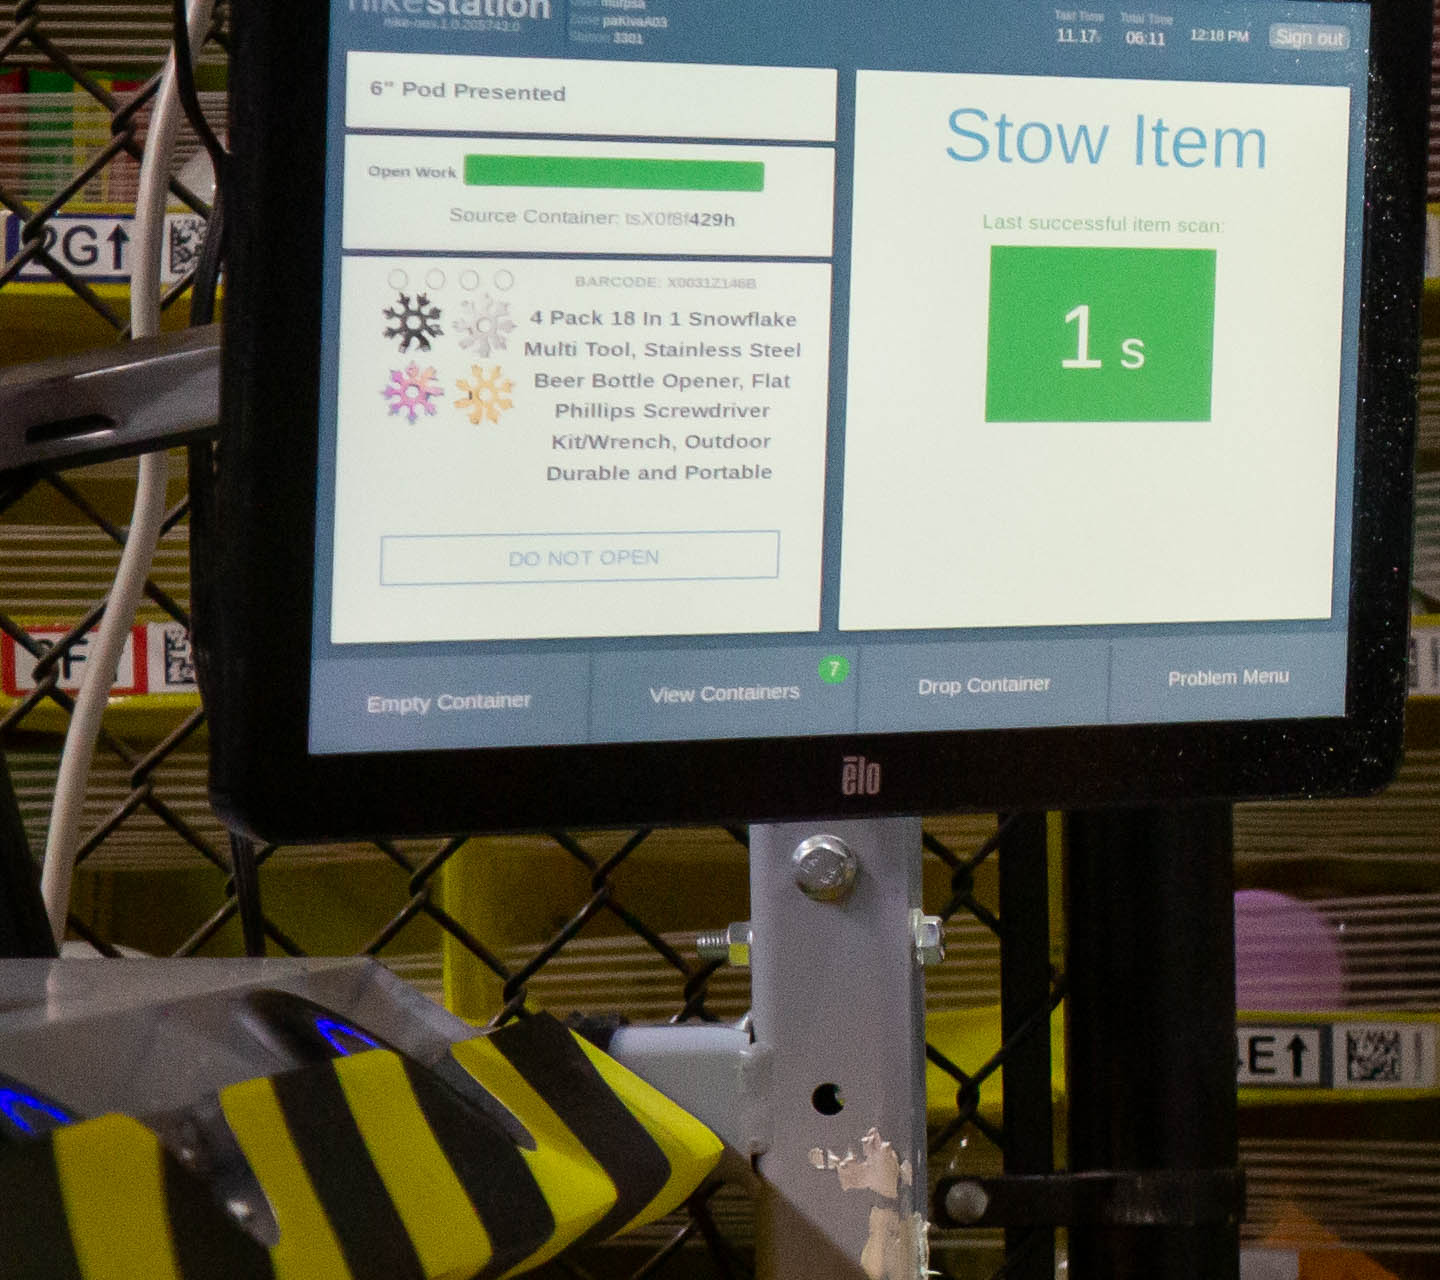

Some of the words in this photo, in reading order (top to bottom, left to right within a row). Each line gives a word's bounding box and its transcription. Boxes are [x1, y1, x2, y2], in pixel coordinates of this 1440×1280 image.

[1125, 30, 1166, 46] 06:11
[1190, 28, 1225, 42] 12:18
[1228, 29, 1250, 43] PM
[1276, 28, 1313, 50] Sign
[1317, 30, 1345, 47] out
[369, 80, 394, 97] 6"
[402, 81, 446, 98] Pod
[454, 82, 567, 103] Presented
[946, 107, 1110, 164] Stow
[1135, 113, 1267, 169] Item
[368, 165, 411, 180] Open
[415, 166, 457, 179] Work
[449, 207, 517, 223] Source
[523, 209, 620, 226] Container:
[983, 213, 1023, 231] Last
[1028, 214, 1128, 233] successful
[1132, 216, 1171, 233] item
[1178, 219, 1225, 234] scan:
[575, 275, 661, 289] BARCODE:
[530, 310, 543, 325] 4
[550, 310, 603, 326] Pack
[612, 311, 636, 326] 18
[643, 311, 662, 326] In
[670, 311, 682, 326] 1
[688, 311, 797, 328] Snowflake
[1061, 304, 1103, 368] 1
[1120, 337, 1146, 370] s
[523, 340, 577, 358] Multi
[585, 341, 637, 360] Tool,
[643, 341, 742, 358] Stainless
[749, 342, 802, 358] Steel
[533, 372, 585, 388] Beer
[591, 372, 655, 388] Bottle
[662, 372, 744, 392] Opener,
[751, 373, 791, 389] Flat
[555, 403, 636, 422] Phillips
[643, 403, 771, 419] Screwdriver
[551, 433, 678, 452] Kit/Wrench,
[684, 433, 772, 450] Outdoor
[546, 464, 630, 481] Durable
[637, 464, 677, 481] and
[685, 464, 773, 481] Portable
[508, 551, 541, 568] DO
[548, 550, 592, 568] NOT
[600, 548, 660, 567] OPEN
[828, 660, 841, 678] 7
[1168, 668, 1238, 688] Problem
[1243, 667, 1290, 686] Menu
[649, 685, 695, 704] View
[700, 682, 800, 702] Containers
[918, 678, 962, 698] Drop
[967, 675, 1052, 695] Container
[366, 695, 431, 715] Empty
[437, 691, 531, 711] Container
[1238, 1035, 1276, 1074] E
